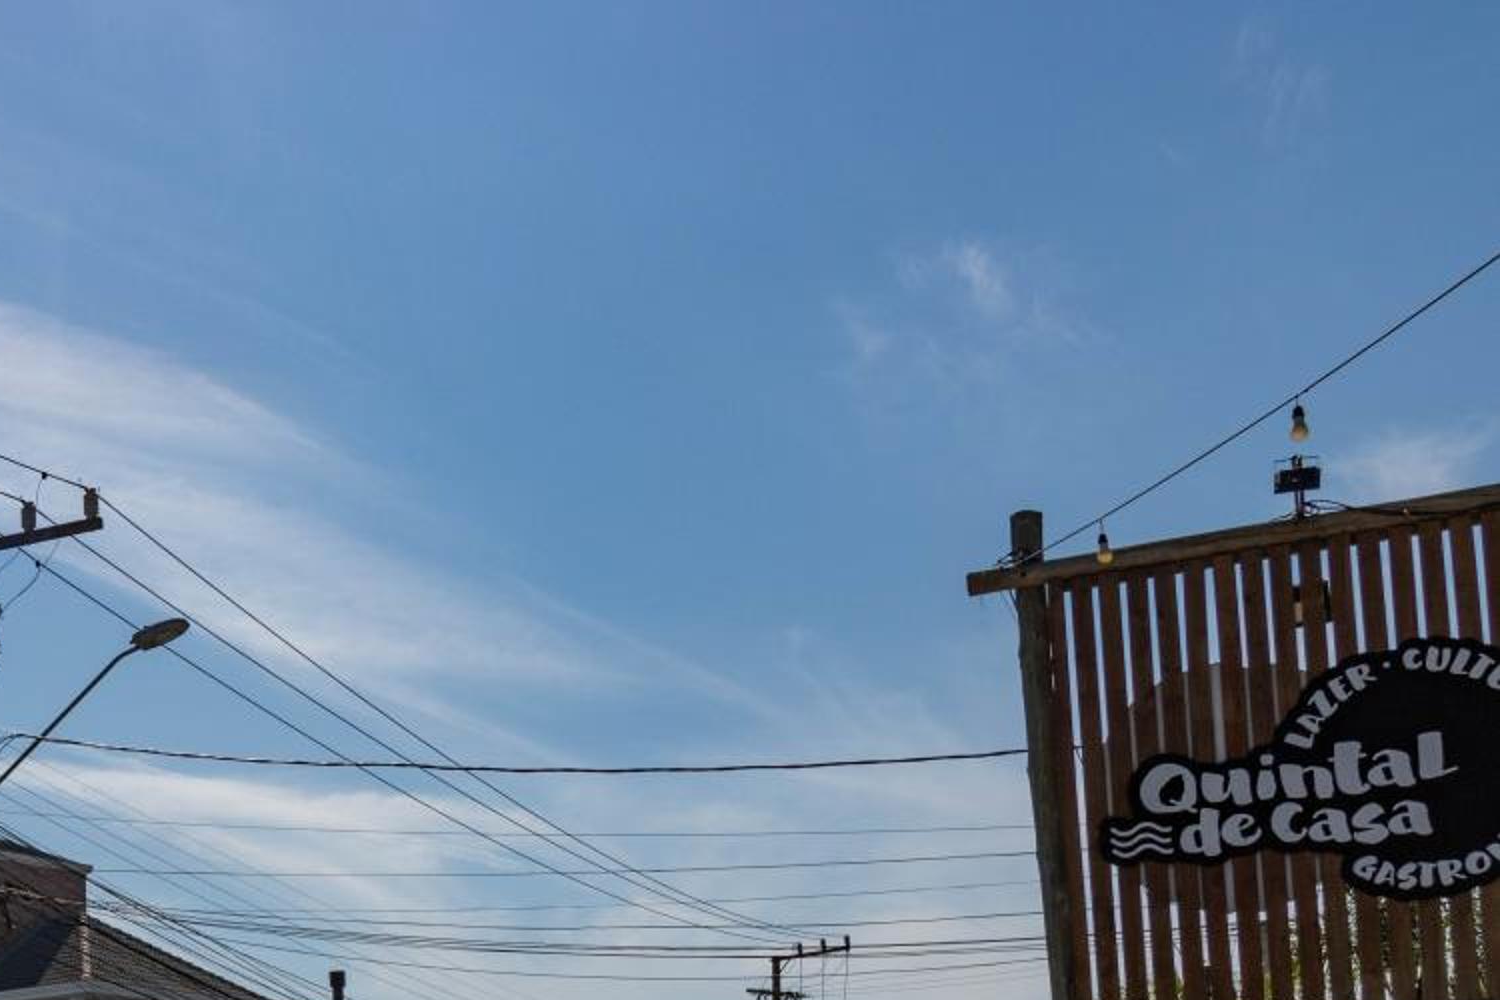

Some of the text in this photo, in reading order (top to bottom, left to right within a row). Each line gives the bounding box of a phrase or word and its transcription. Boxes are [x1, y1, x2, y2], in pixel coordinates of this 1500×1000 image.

[1284, 663, 1379, 750] LAZER
[1140, 731, 1460, 815] Quintal
[1179, 807, 1263, 857] de
